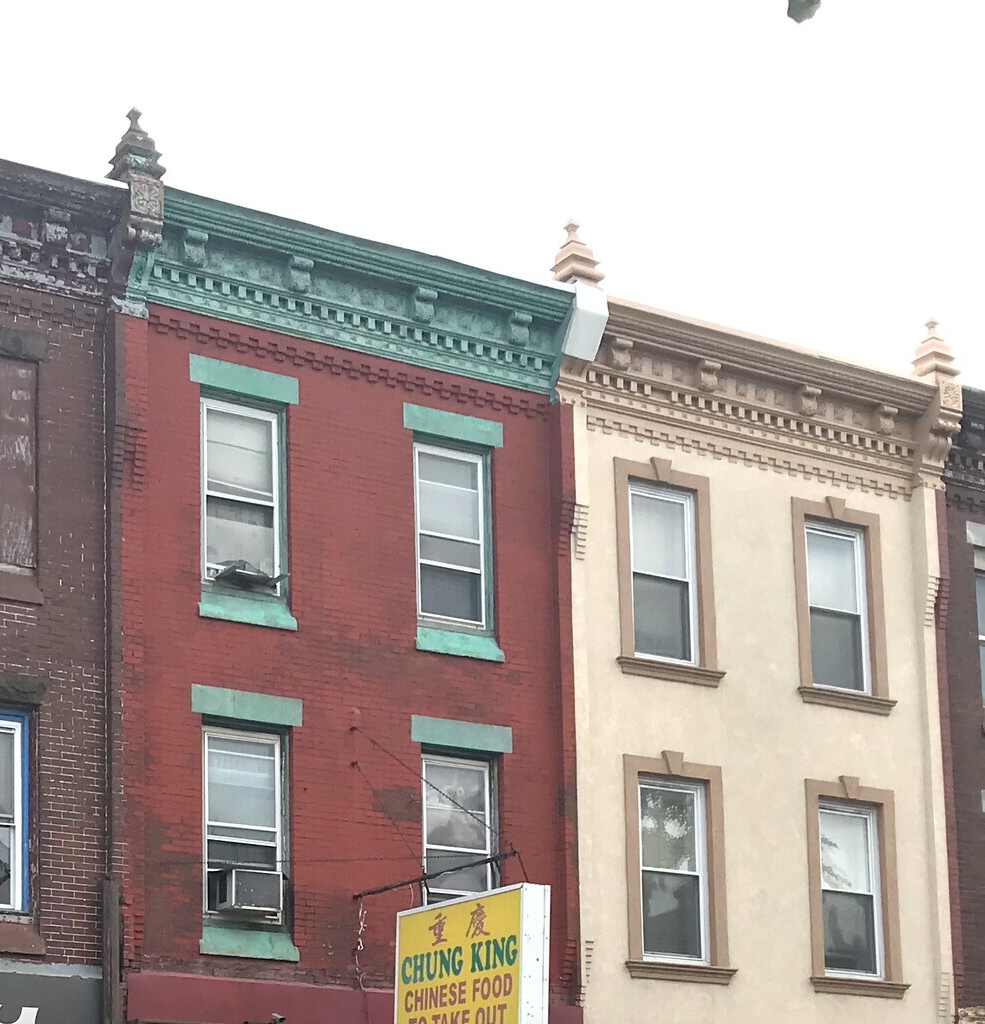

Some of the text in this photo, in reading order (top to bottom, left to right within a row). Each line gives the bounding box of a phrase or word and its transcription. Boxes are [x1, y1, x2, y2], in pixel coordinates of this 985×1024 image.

[429, 913, 447, 946] 重
[401, 934, 518, 985] CHUNG KING
[404, 973, 513, 1013] CHINESE FOOD
